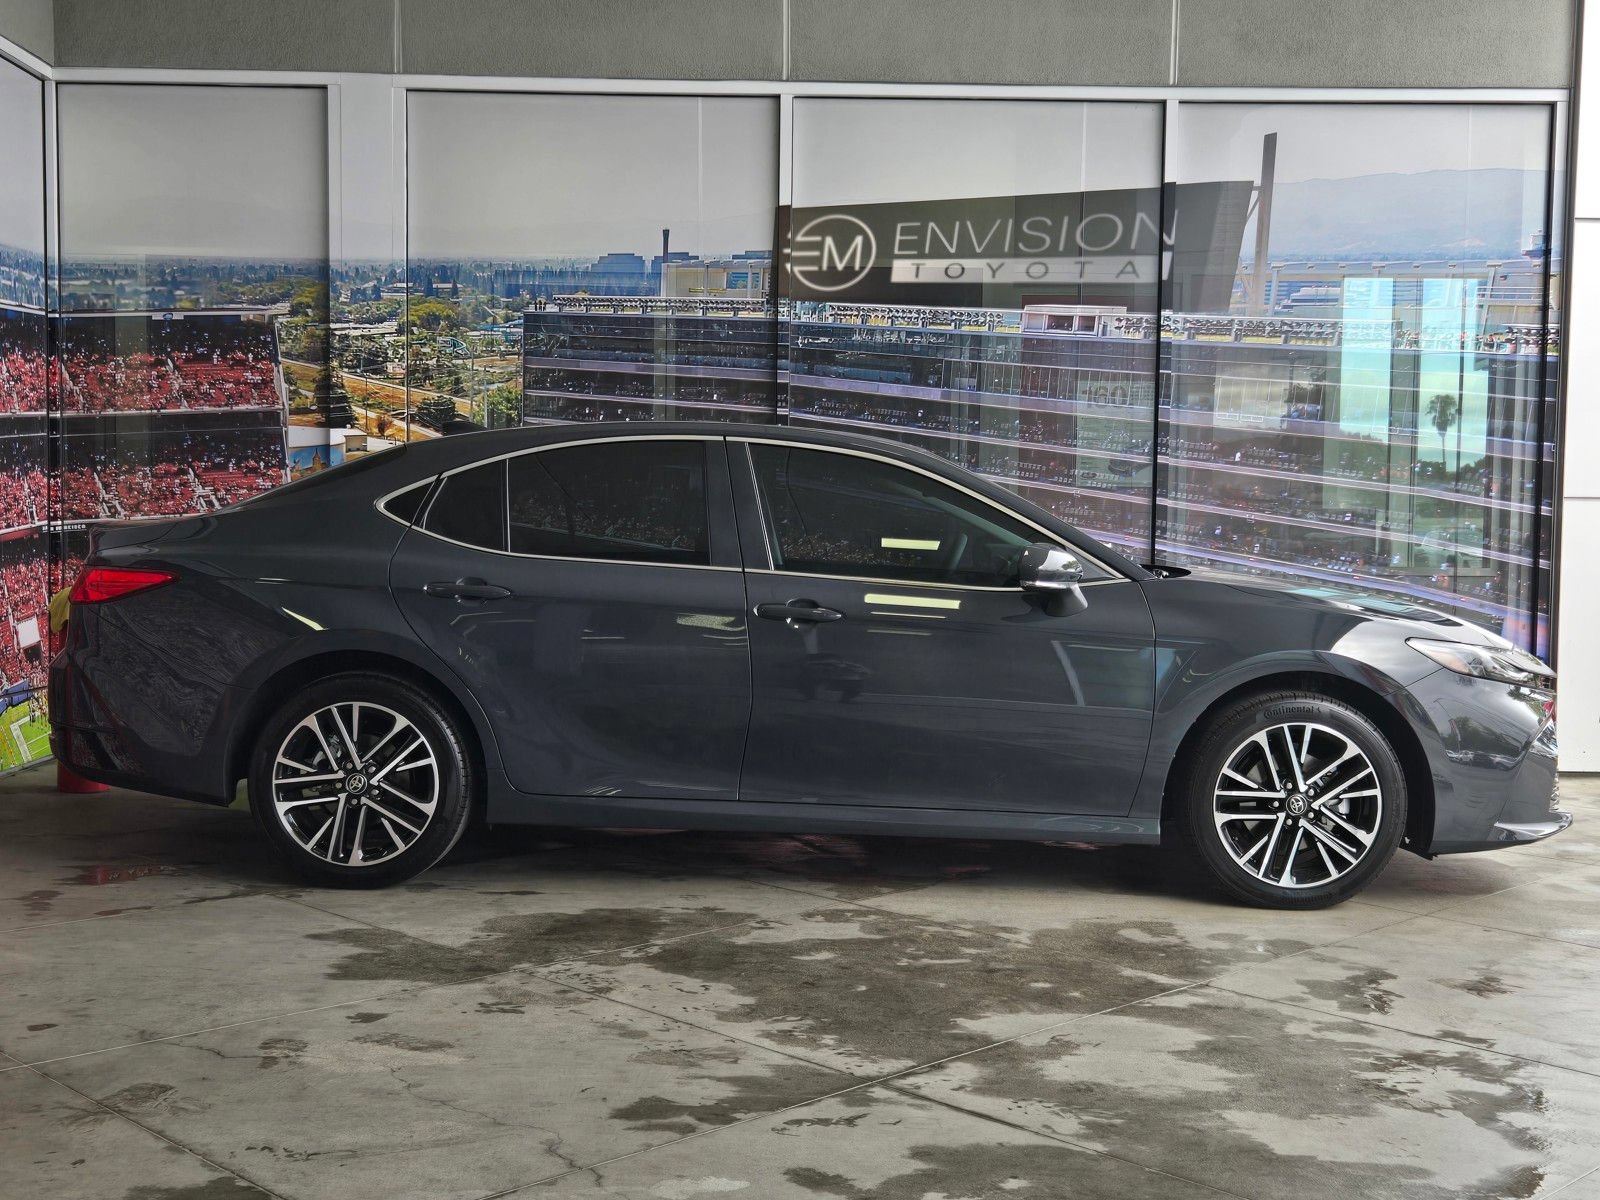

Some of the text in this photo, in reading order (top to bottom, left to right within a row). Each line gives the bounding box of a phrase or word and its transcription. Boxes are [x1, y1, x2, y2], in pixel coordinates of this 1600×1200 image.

[893, 209, 1178, 255] ENVISION
[910, 260, 1142, 281] TOYOTA
[1263, 705, 1314, 719] Continental
